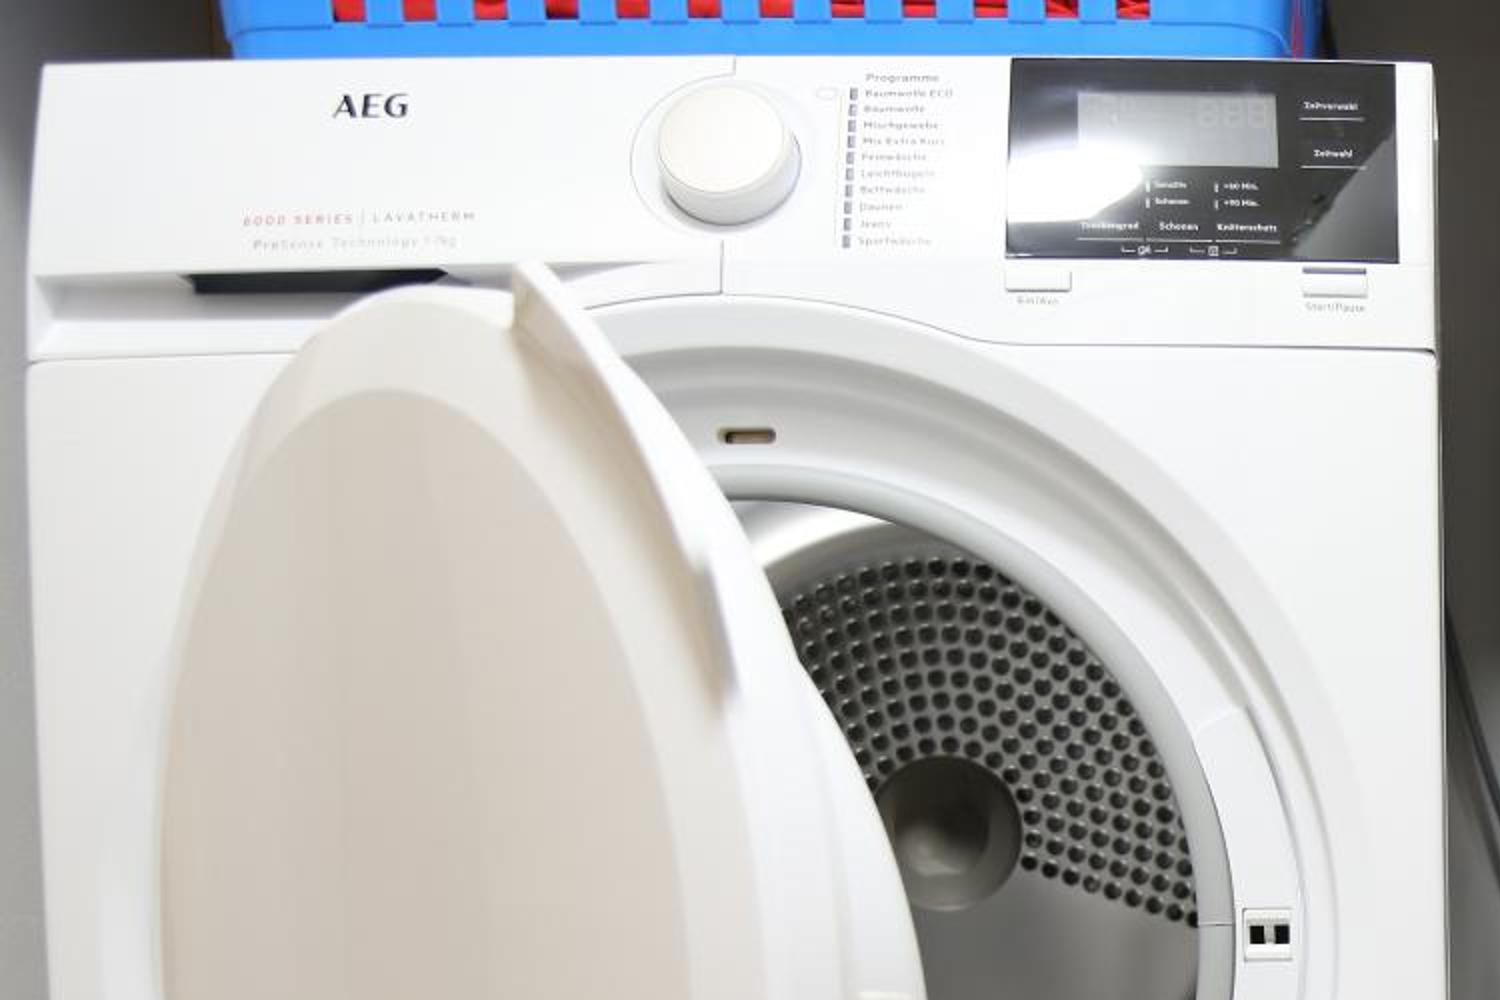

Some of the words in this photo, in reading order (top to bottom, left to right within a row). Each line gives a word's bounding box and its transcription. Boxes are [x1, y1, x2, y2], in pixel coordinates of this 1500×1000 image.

[332, 93, 409, 119] AEG
[296, 212, 352, 225] SERIES
[373, 210, 476, 224] LAVATHERM
